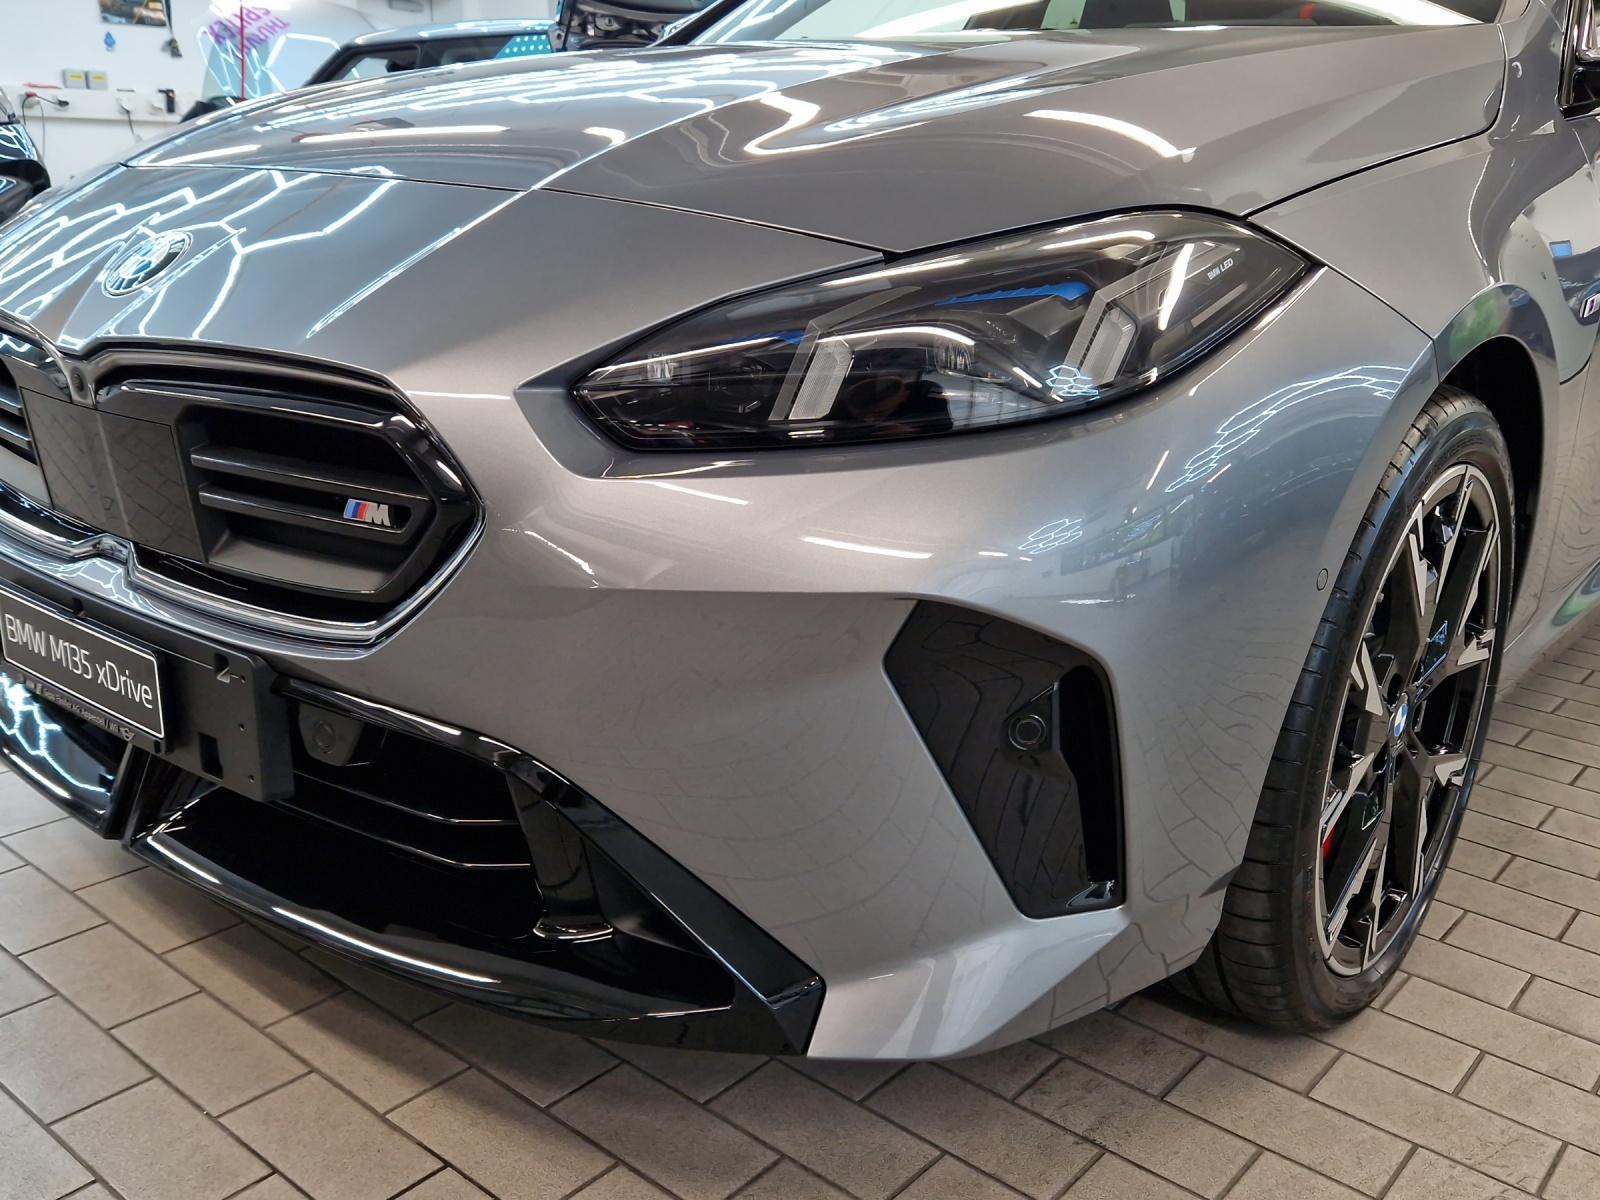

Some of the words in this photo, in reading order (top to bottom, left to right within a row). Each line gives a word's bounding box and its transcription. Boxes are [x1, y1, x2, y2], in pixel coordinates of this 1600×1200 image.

[1207, 266, 1221, 280] BMW
[1220, 258, 1234, 272] LED
[364, 501, 391, 527] M
[4, 613, 47, 657] BMW
[49, 634, 93, 680] M135
[95, 660, 153, 709] xDrive
